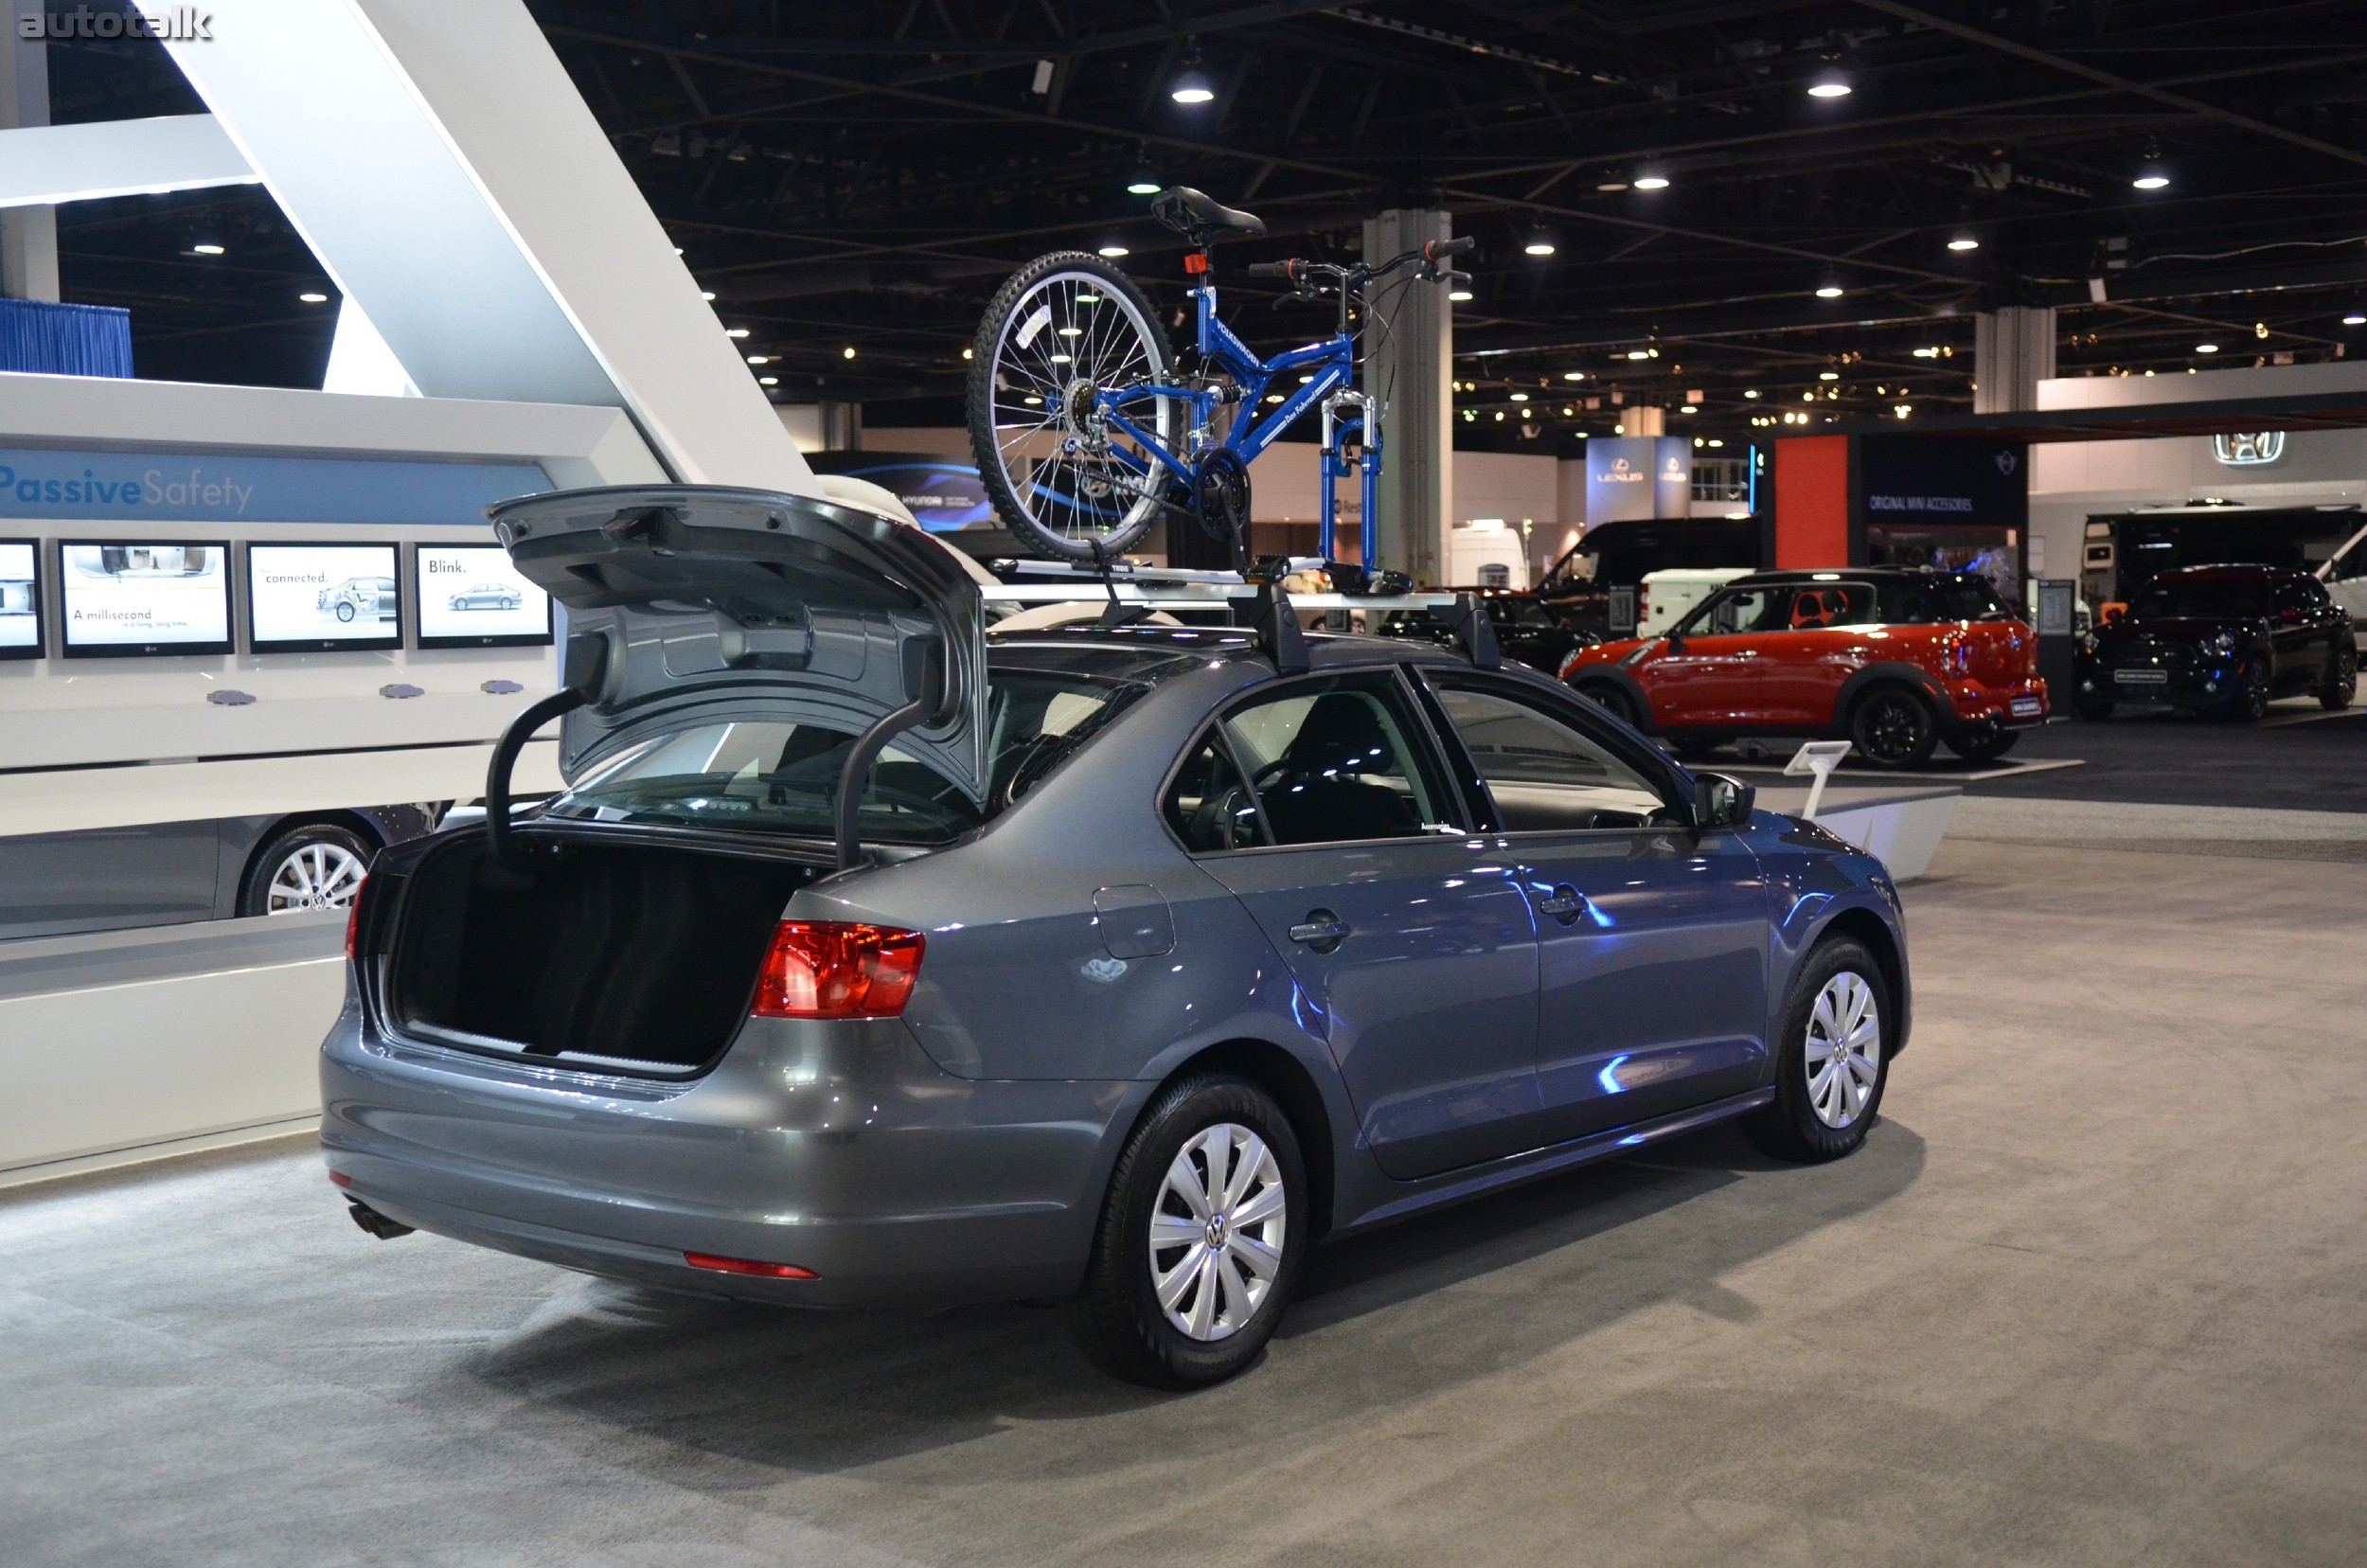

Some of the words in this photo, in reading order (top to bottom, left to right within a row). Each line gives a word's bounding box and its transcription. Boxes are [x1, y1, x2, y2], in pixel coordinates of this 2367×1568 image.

[1217, 318, 1259, 367] VOLKSWAGEN
[1285, 411, 1297, 423] Das
[1294, 390, 1317, 415] Fahrrad
[1869, 495, 1906, 509] ORIGINAL
[1907, 495, 1926, 510] MINI
[429, 559, 466, 573] Blink.
[266, 572, 329, 583] connected.
[74, 610, 83, 620] A
[87, 609, 152, 620] millisecond
